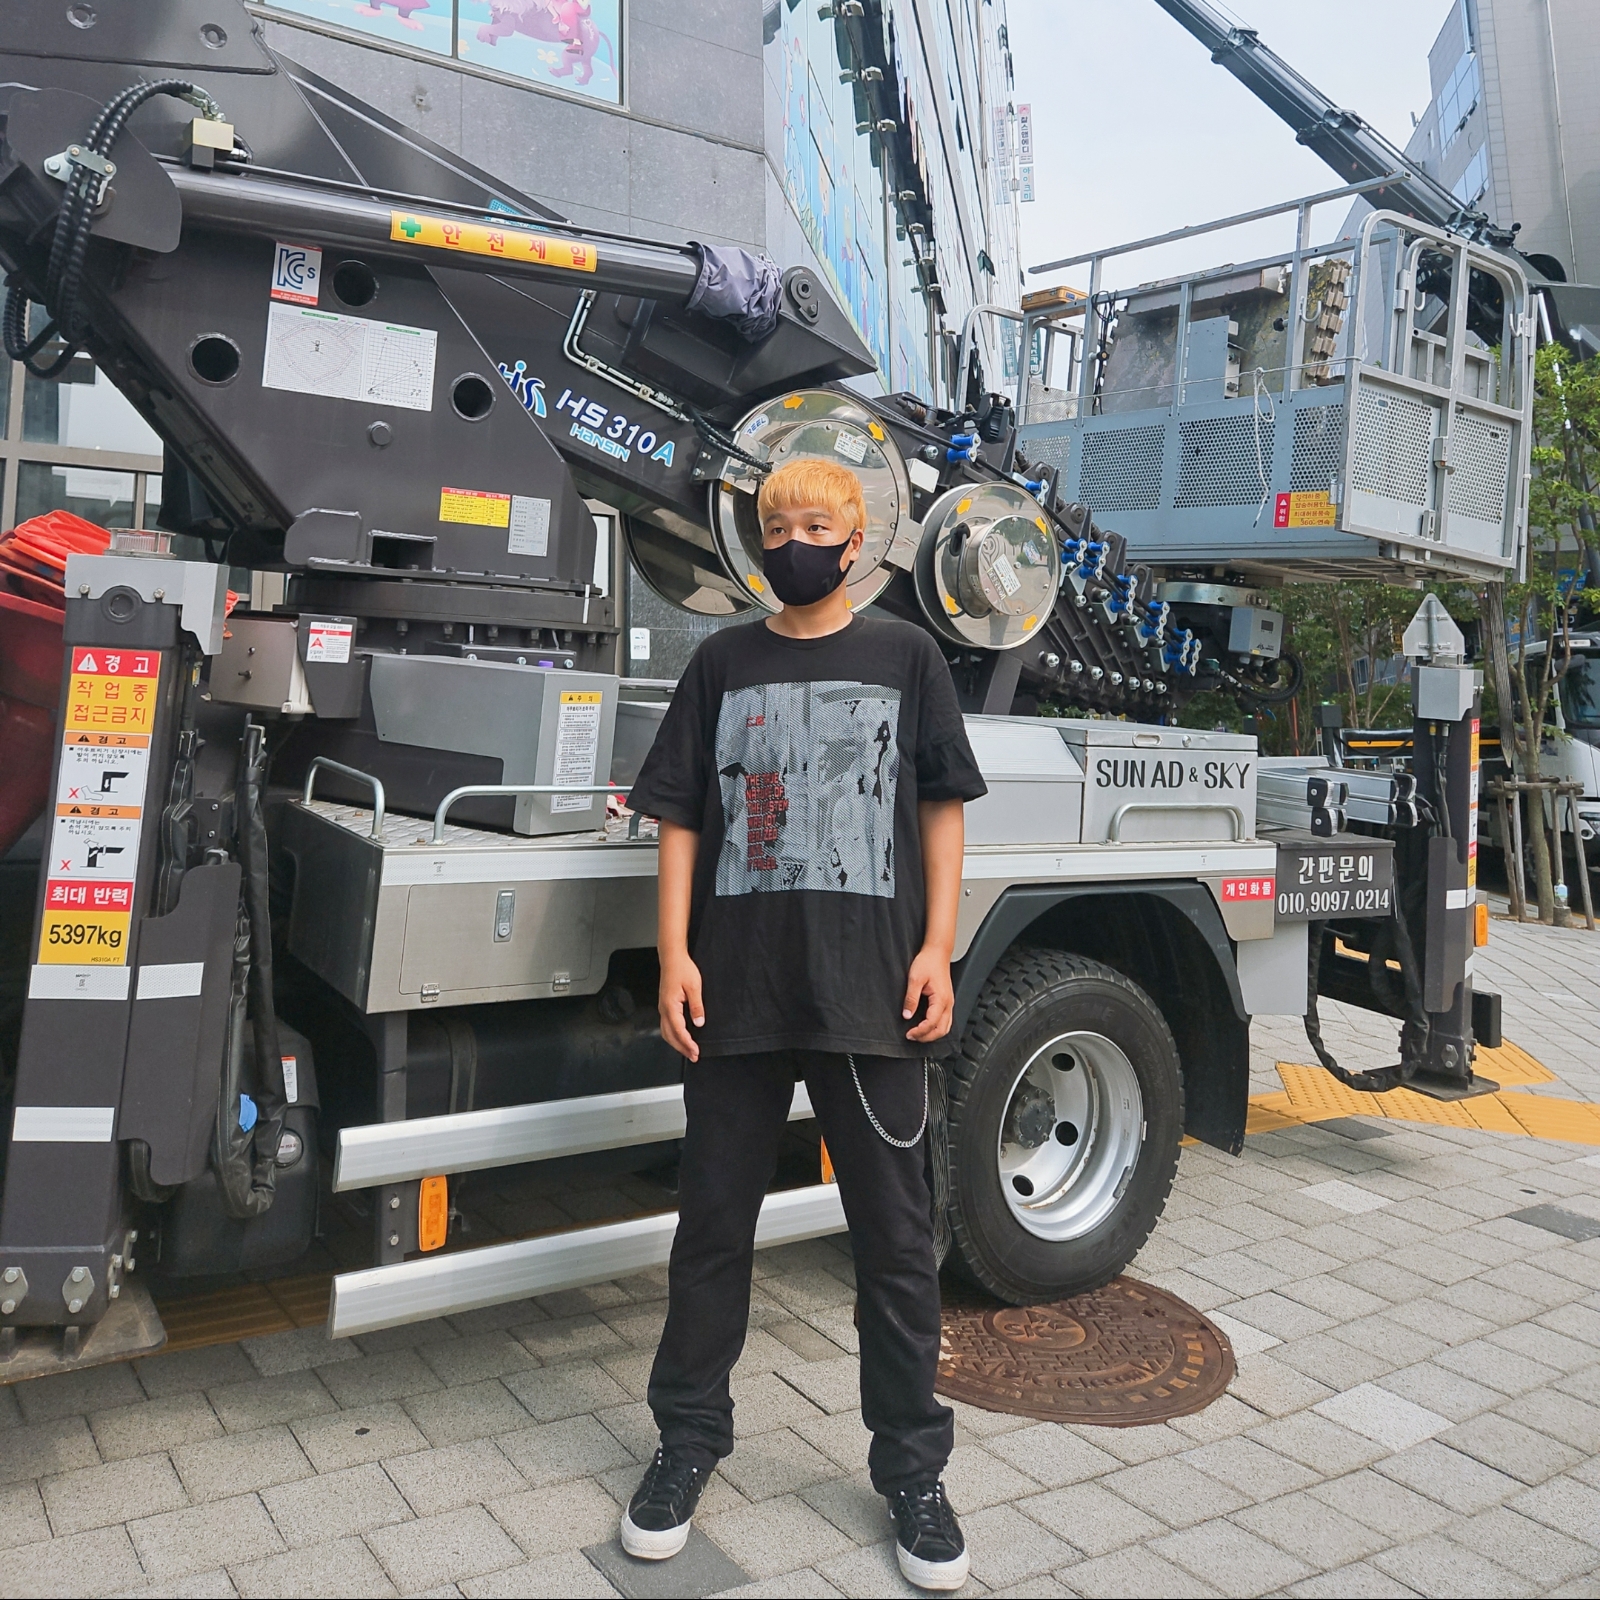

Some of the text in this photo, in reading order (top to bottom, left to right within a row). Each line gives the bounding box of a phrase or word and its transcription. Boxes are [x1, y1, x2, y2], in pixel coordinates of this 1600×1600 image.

[74, 704, 146, 725] 접근금지
[746, 775, 760, 786] THE
[1096, 759, 1250, 789] SUN AD & SKY
[774, 786, 784, 797] OF
[747, 803, 761, 814] THE
[1298, 855, 1374, 885] 간판문의
[51, 886, 128, 905] 최대 반력
[1226, 881, 1272, 897] 개인화물
[48, 924, 122, 948] 5397kg
